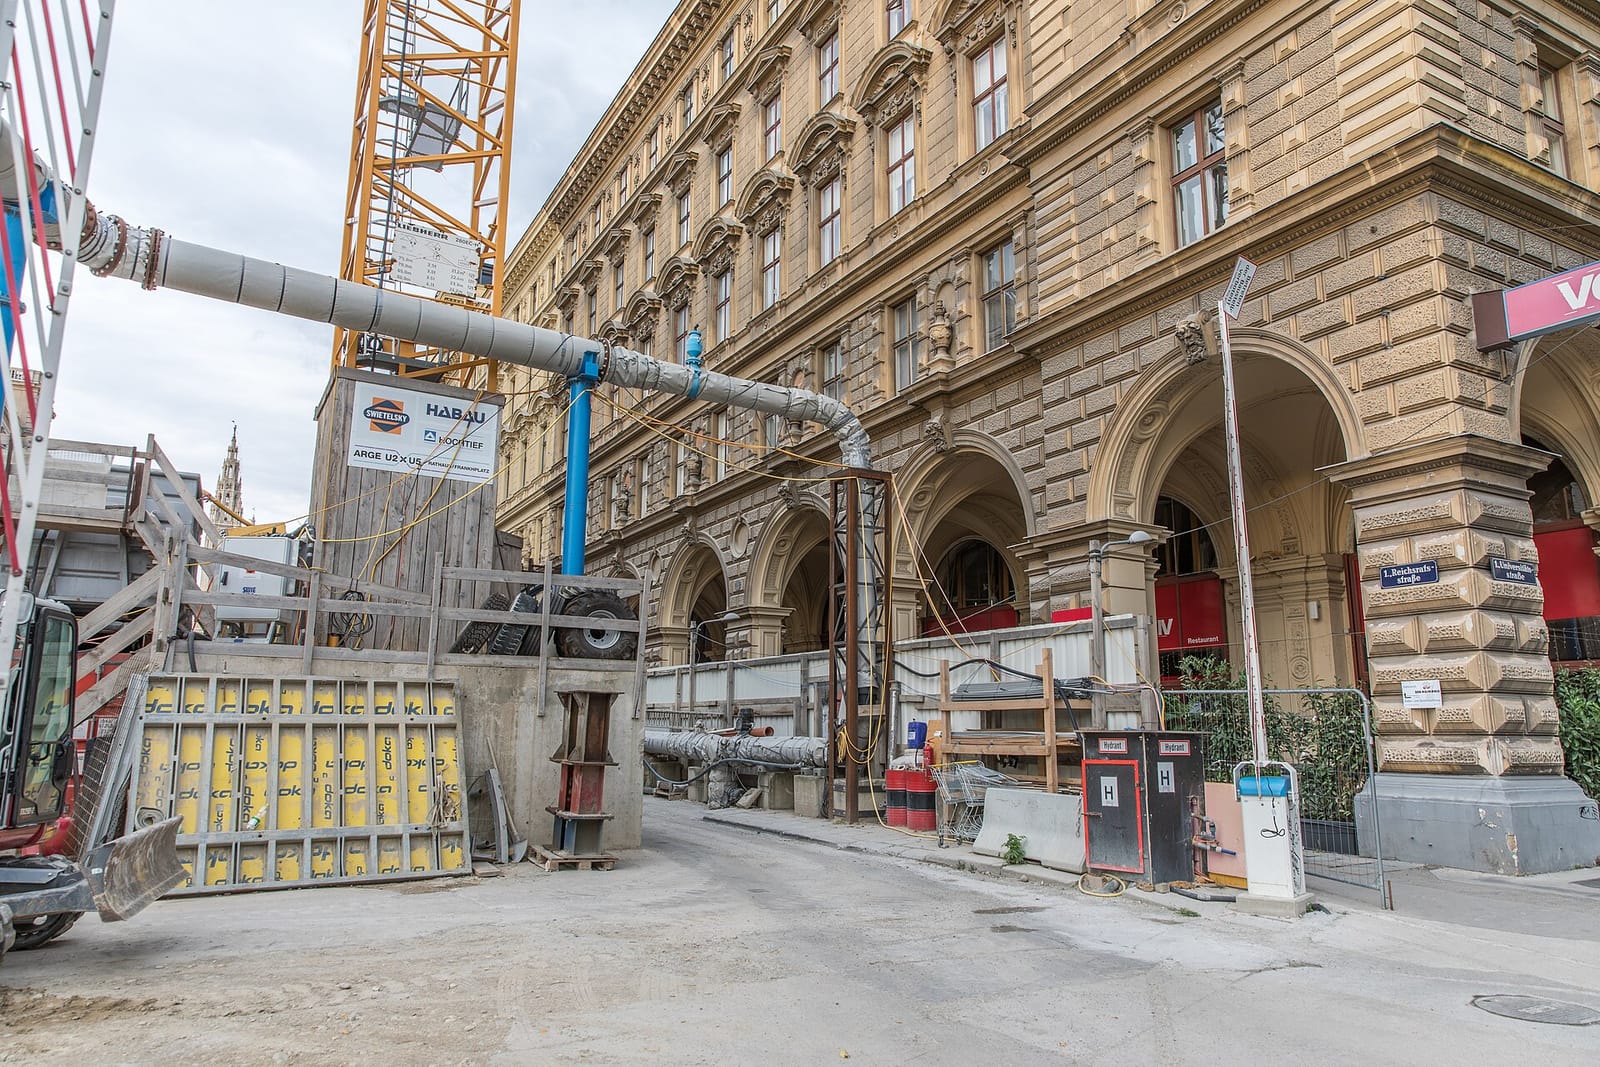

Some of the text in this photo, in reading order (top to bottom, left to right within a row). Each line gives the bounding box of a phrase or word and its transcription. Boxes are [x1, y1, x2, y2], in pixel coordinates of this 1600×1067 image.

[397, 223, 449, 241] LIEBHERR
[1556, 273, 1600, 310] V
[365, 409, 408, 423] SWIETELSKY
[426, 403, 486, 424] HABAU
[353, 449, 382, 460] ARGE
[1187, 636, 1219, 645] Restaurant
[382, 737, 392, 770] doka
[1103, 741, 1122, 751] Hydrant
[1165, 743, 1185, 753] Hydrant
[1160, 770, 1170, 786] H
[1104, 786, 1114, 801] H
[324, 784, 334, 820] doka
